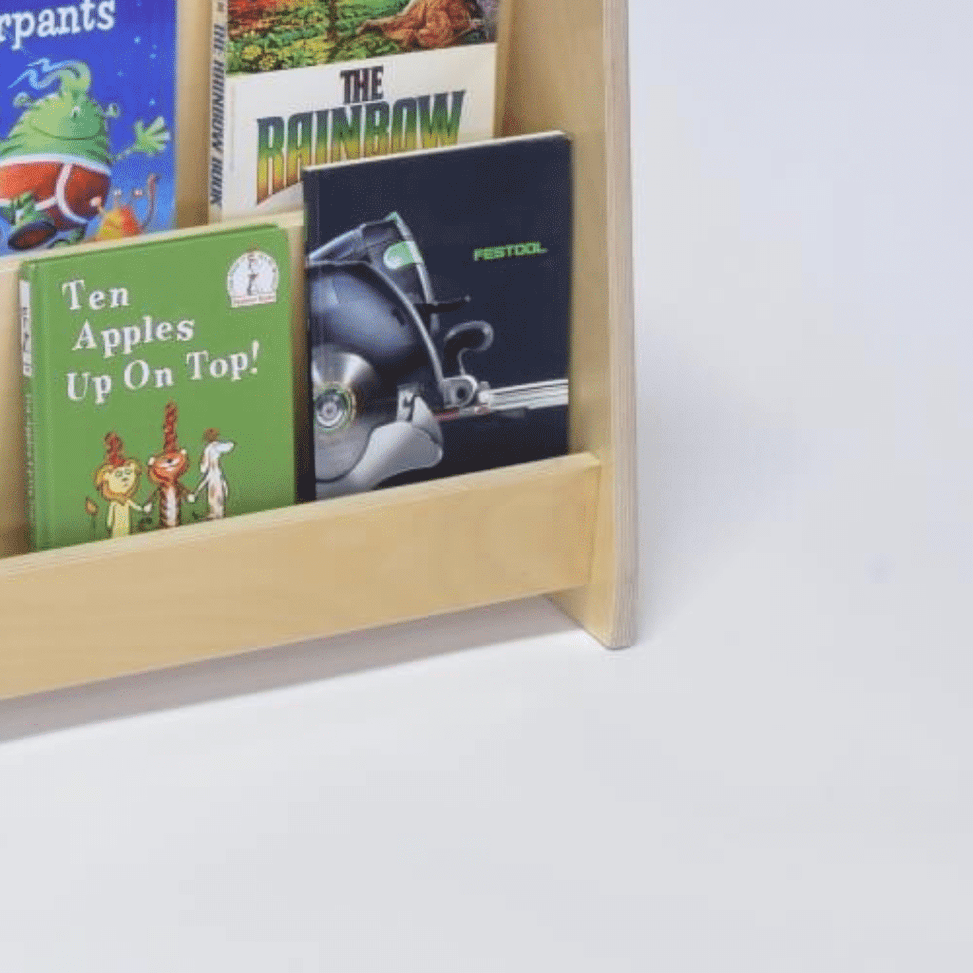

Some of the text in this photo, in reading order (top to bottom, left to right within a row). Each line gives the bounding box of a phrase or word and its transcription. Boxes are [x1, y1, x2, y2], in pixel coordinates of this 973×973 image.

[340, 64, 384, 105] THE
[256, 90, 467, 205] RAINBOW
[472, 241, 548, 262] FESTOOL
[61, 278, 131, 311] Ten
[72, 315, 196, 359] Apples
[66, 340, 261, 405] Up On Top!
